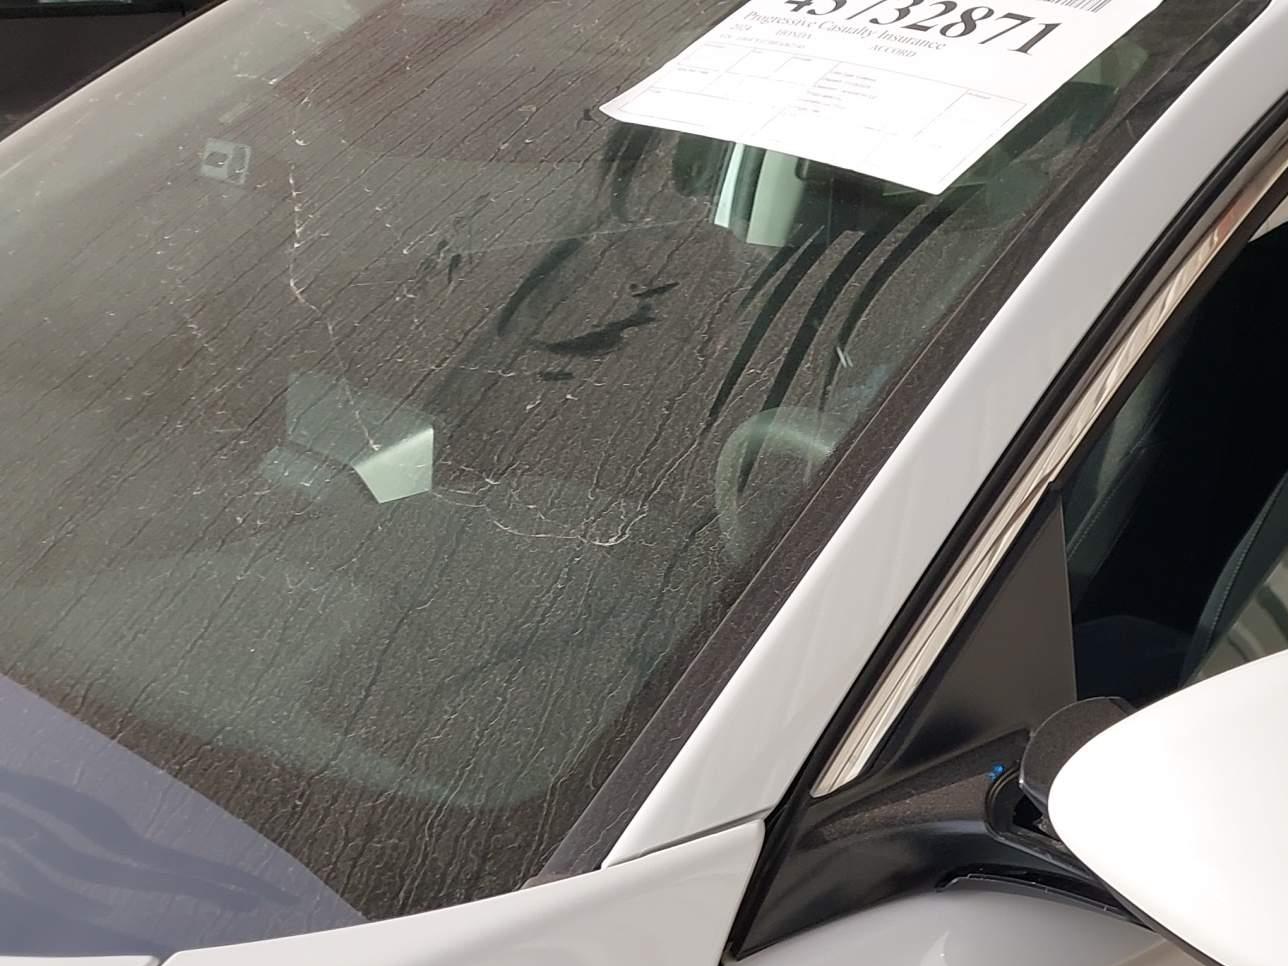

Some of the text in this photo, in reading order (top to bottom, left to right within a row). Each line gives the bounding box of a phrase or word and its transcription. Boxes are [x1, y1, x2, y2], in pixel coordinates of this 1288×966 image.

[744, 11, 947, 50] Progressive Casualty Insurance
[869, 44, 918, 58] ACCORD
